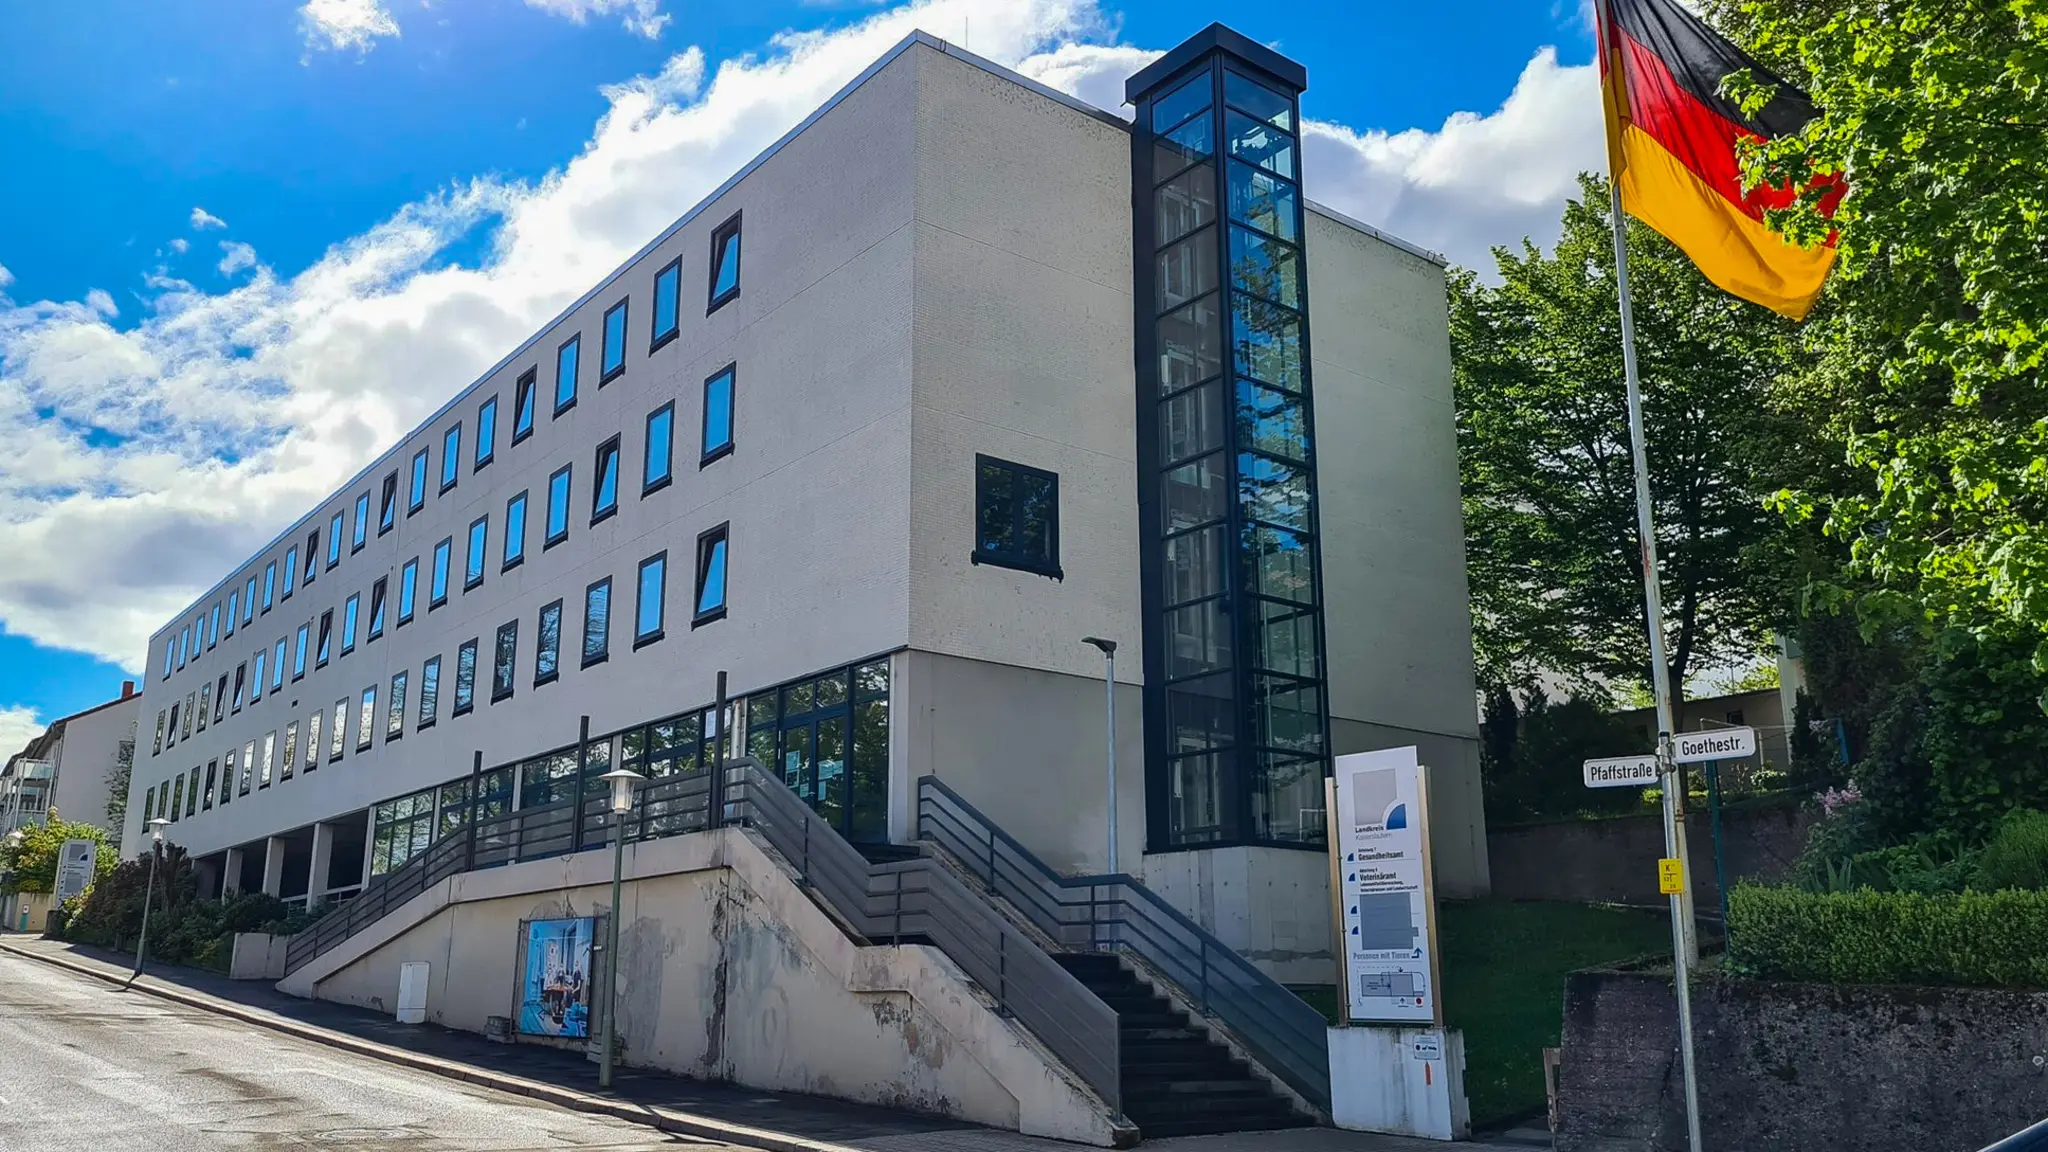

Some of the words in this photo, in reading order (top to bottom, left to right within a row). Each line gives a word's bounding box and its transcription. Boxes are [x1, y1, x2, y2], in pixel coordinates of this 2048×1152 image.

[1682, 736, 1745, 756] Goethestr.
[1591, 763, 1653, 781] Pfaffstraße
[1355, 825, 1384, 833] Landkreis
[1358, 851, 1403, 860] Gesundheitsamt
[1360, 872, 1396, 880] Veterinäramt
[1391, 951, 1410, 959] Tieren
